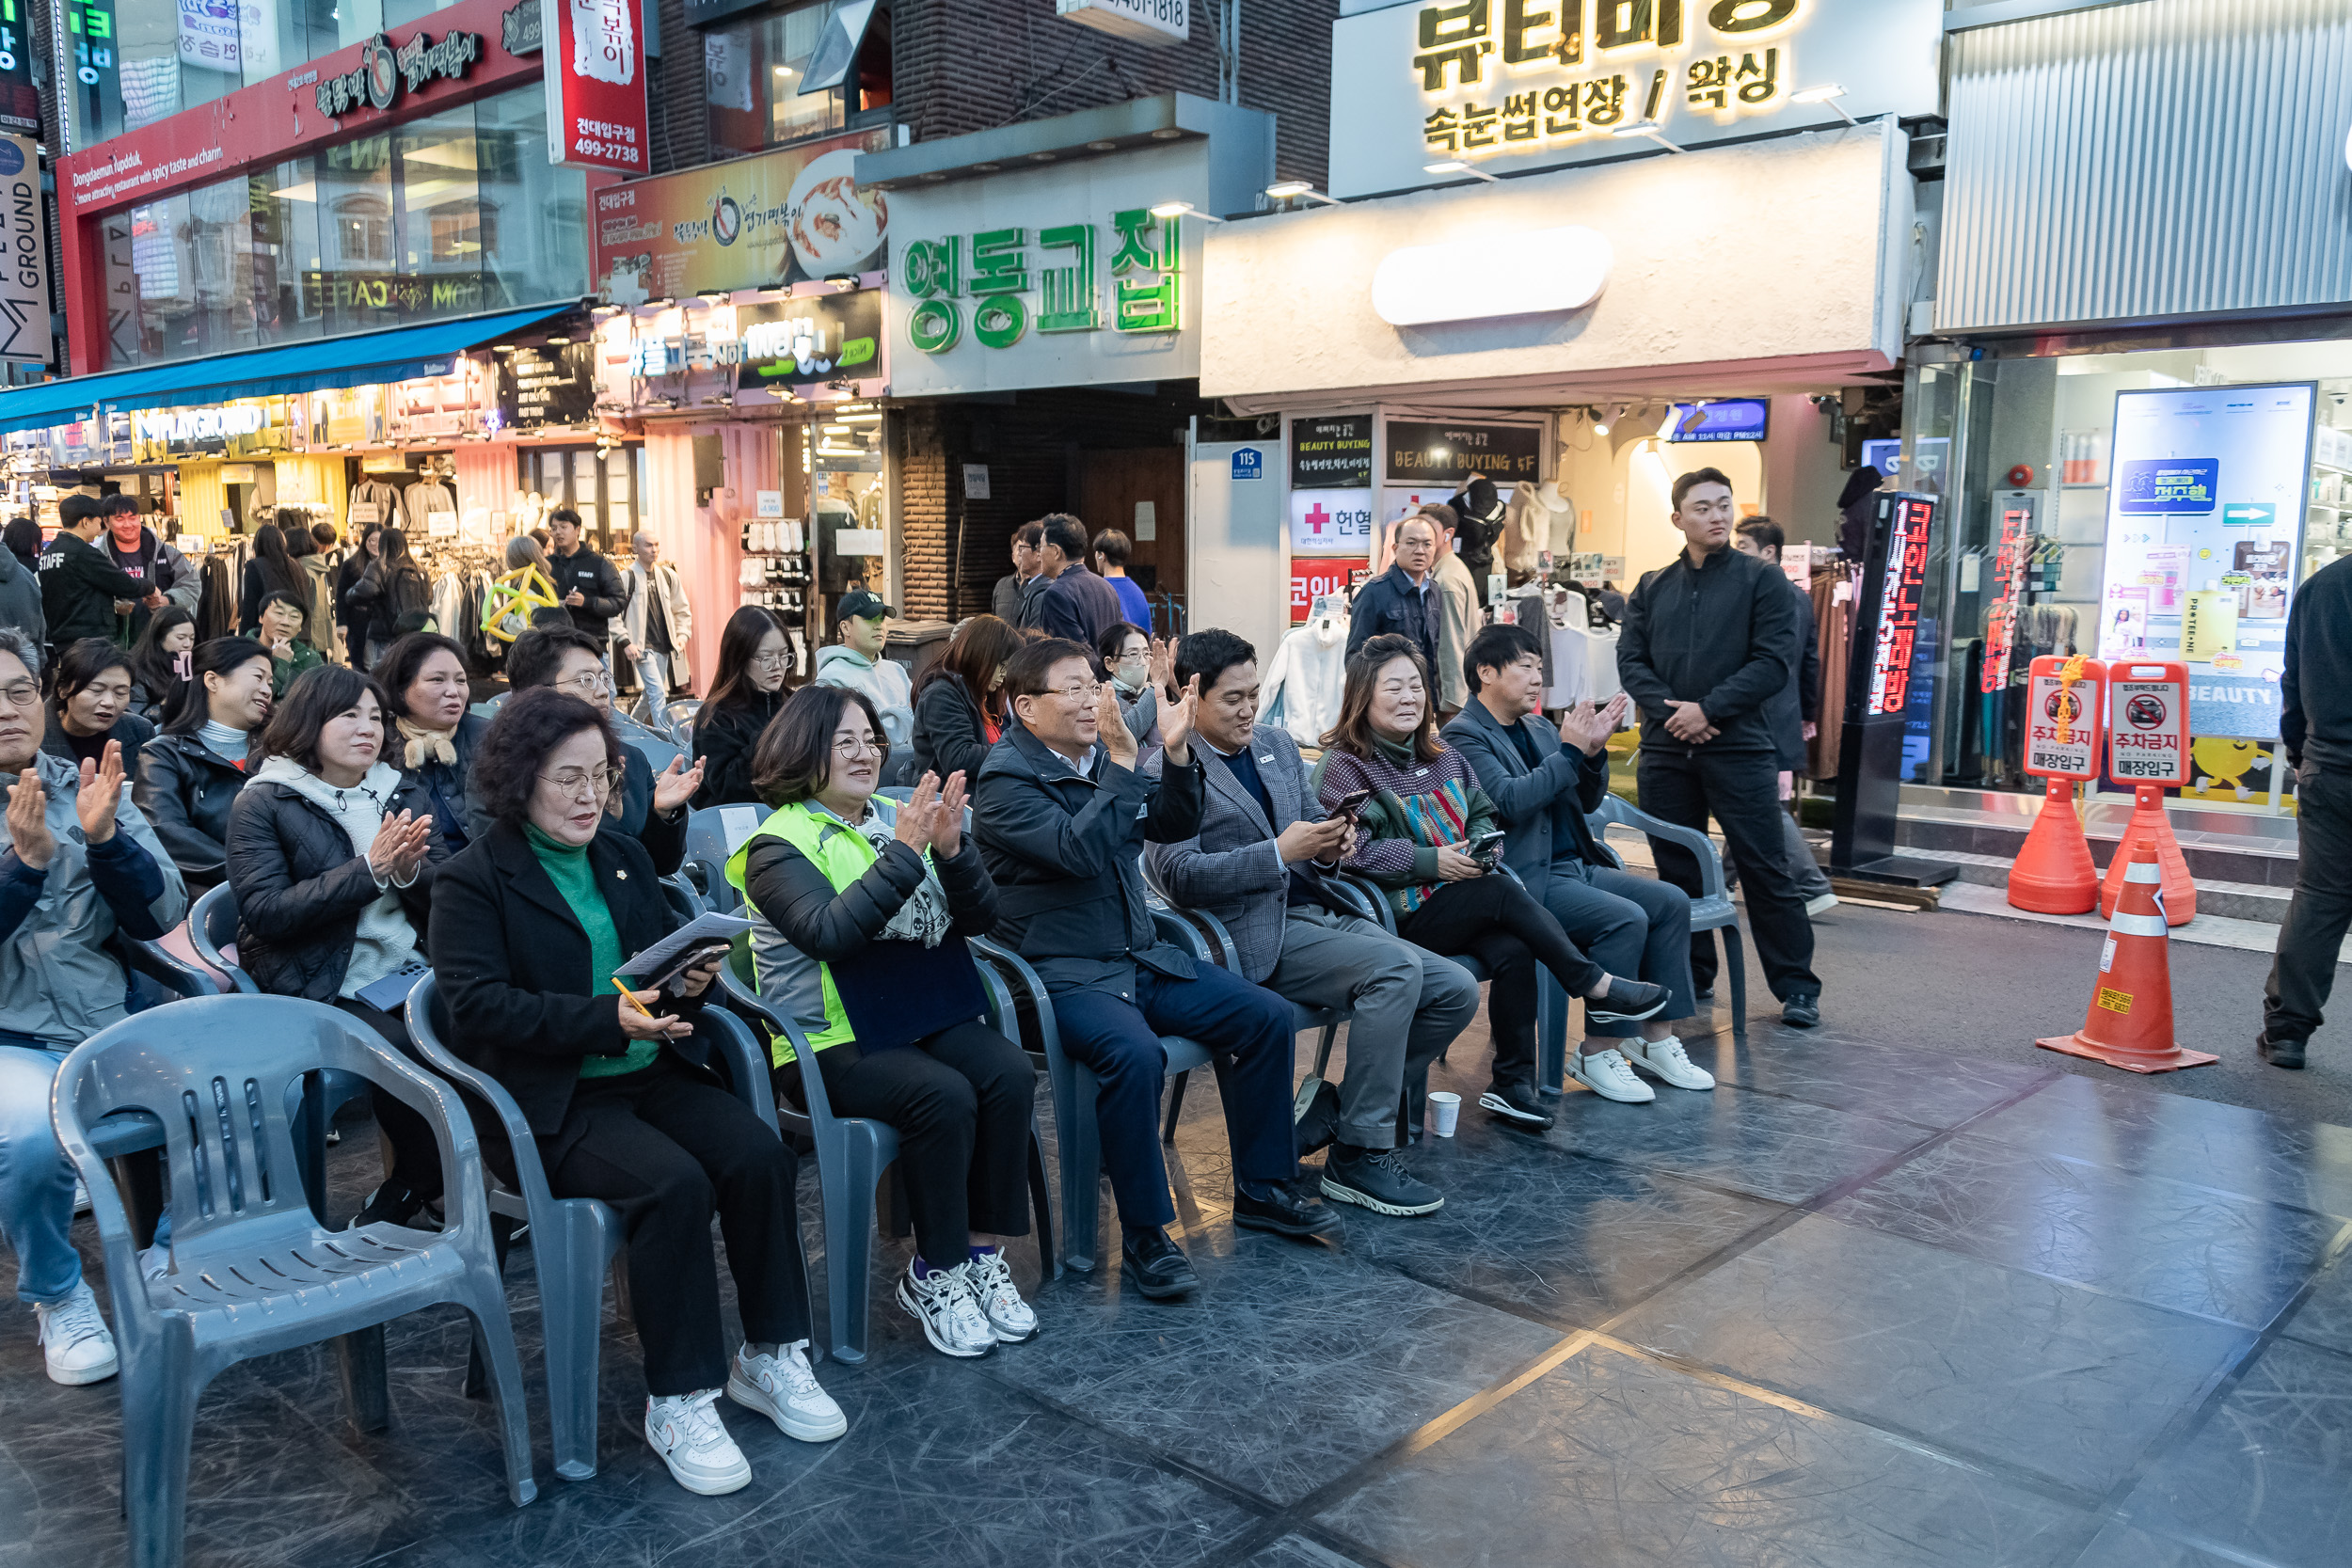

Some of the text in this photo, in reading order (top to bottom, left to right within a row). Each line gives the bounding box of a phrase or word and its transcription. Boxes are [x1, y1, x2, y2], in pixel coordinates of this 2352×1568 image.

[1423, 74, 1629, 150] 속눈썹연장
[1687, 48, 1779, 109] 왁싱
[577, 118, 636, 142] 건대입구점
[575, 138, 639, 163] 499-2738
[73, 165, 114, 187] Dongdaemun
[114, 176, 139, 193] restaurant
[140, 170, 151, 183] with
[152, 162, 169, 182] spicy
[169, 158, 186, 172] taste
[187, 153, 199, 168] and
[599, 189, 635, 211] 건대입구점
[744, 202, 802, 233] 엽기떡볶이
[12, 182, 40, 290] GROUND
[899, 208, 1180, 354] 영동교집
[1300, 439, 1371, 451] BEAUTY BUYING
[1239, 452, 1255, 466] 115
[1395, 451, 1453, 468] BEAUTY
[1457, 453, 1511, 470] BUYING
[1336, 510, 1371, 535] 헌혈
[39, 552, 65, 571] STAFF
[1883, 502, 1931, 714] 코인노래방
[2189, 685, 2272, 705] BEAUTY
[2115, 733, 2178, 751] 주차금지
[2033, 752, 2085, 770] 매장입구
[2119, 760, 2174, 776] 매장입구
